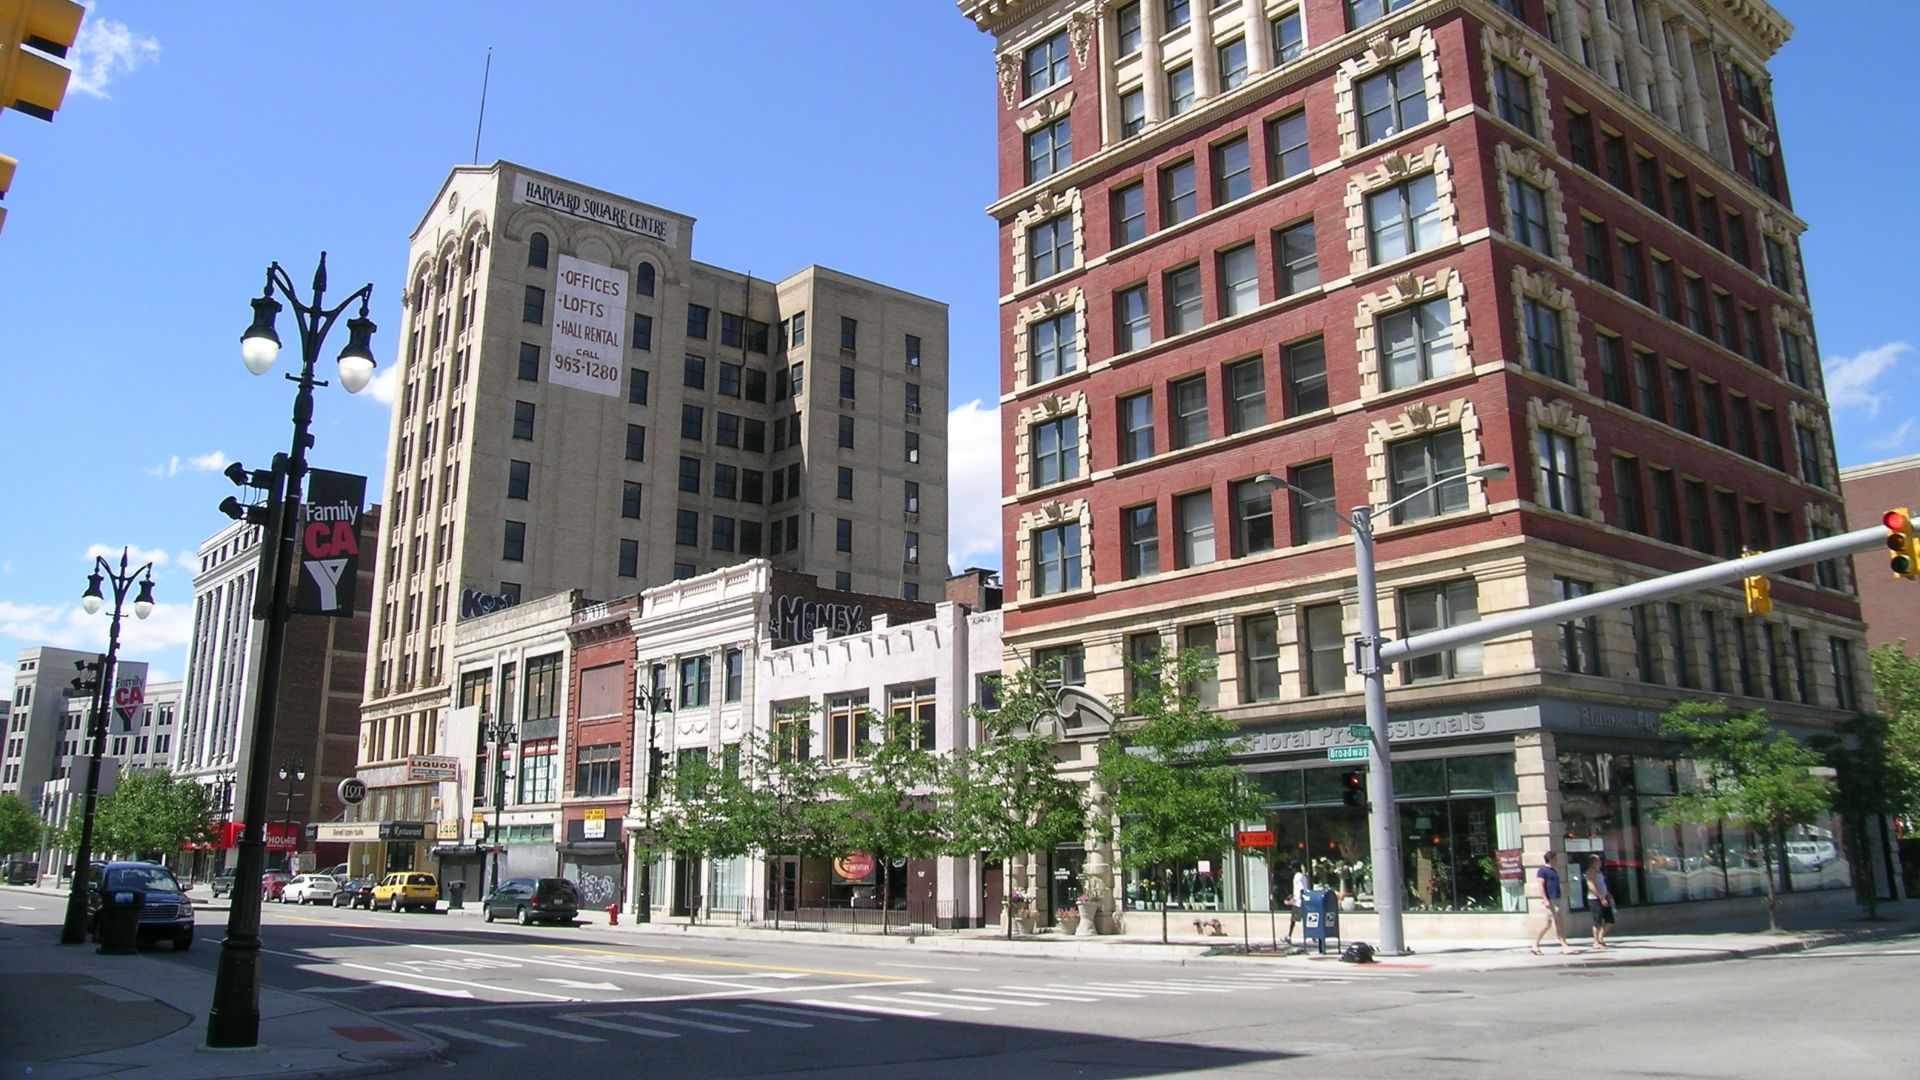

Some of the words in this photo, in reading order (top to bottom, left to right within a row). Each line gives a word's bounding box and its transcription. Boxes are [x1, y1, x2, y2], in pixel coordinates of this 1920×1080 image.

[526, 181, 580, 211] HARVARD
[582, 198, 627, 229] SQUARE
[629, 212, 667, 237] CENTRE
[566, 270, 619, 296] OFFICES
[563, 297, 604, 318] LOFTS
[561, 319, 583, 340] HALL
[584, 325, 619, 347] RENTAL
[576, 348, 599, 360] CALL
[555, 354, 618, 382] 963-1280
[306, 499, 358, 526] Family
[304, 521, 359, 559] CA
[778, 594, 863, 643] MONEY
[116, 675, 144, 688] Family
[115, 687, 144, 705] CA
[1250, 728, 1311, 752] Floral
[1319, 712, 1485, 746] Prossionals
[411, 761, 457, 769] LIQUOR
[1330, 747, 1368, 759] Broadway
